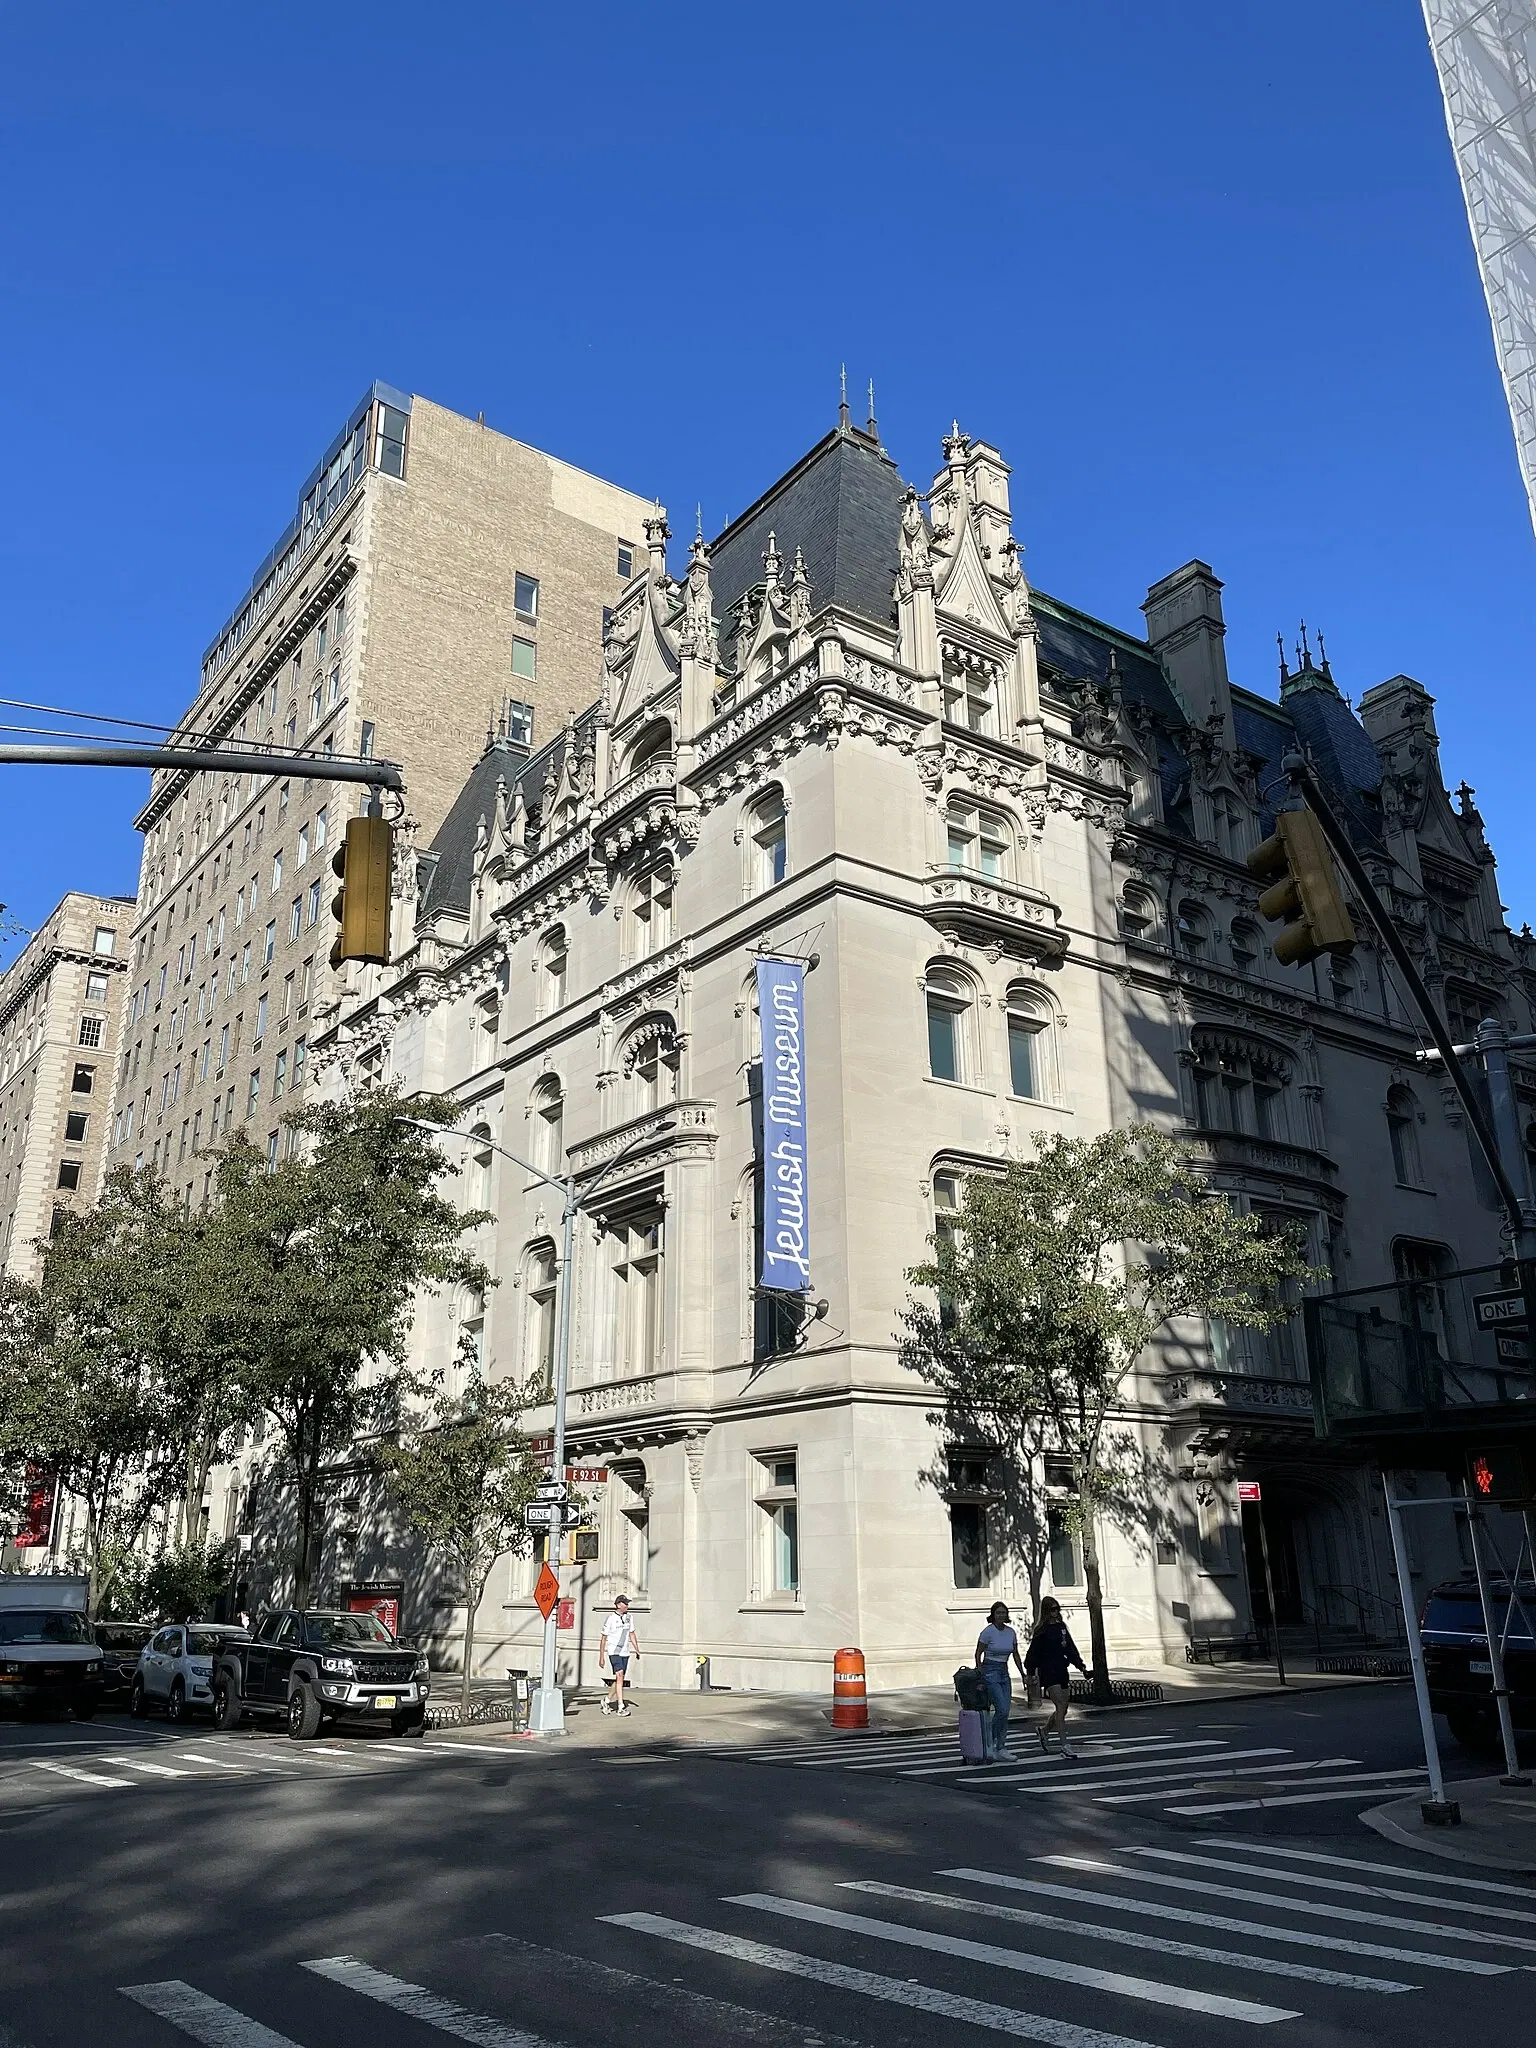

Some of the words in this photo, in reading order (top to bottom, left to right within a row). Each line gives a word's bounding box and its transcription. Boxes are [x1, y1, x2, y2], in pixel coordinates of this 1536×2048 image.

[768, 980, 802, 1128] Museum
[767, 1140, 809, 1276] Jewish
[1484, 1301, 1518, 1318] ONE
[1501, 1340, 1520, 1355] ONE
[573, 1470, 578, 1480] E
[580, 1471, 589, 1480] 92
[591, 1471, 600, 1480] St
[536, 1489, 549, 1497] ONE
[540, 1581, 554, 1590] ROUGH
